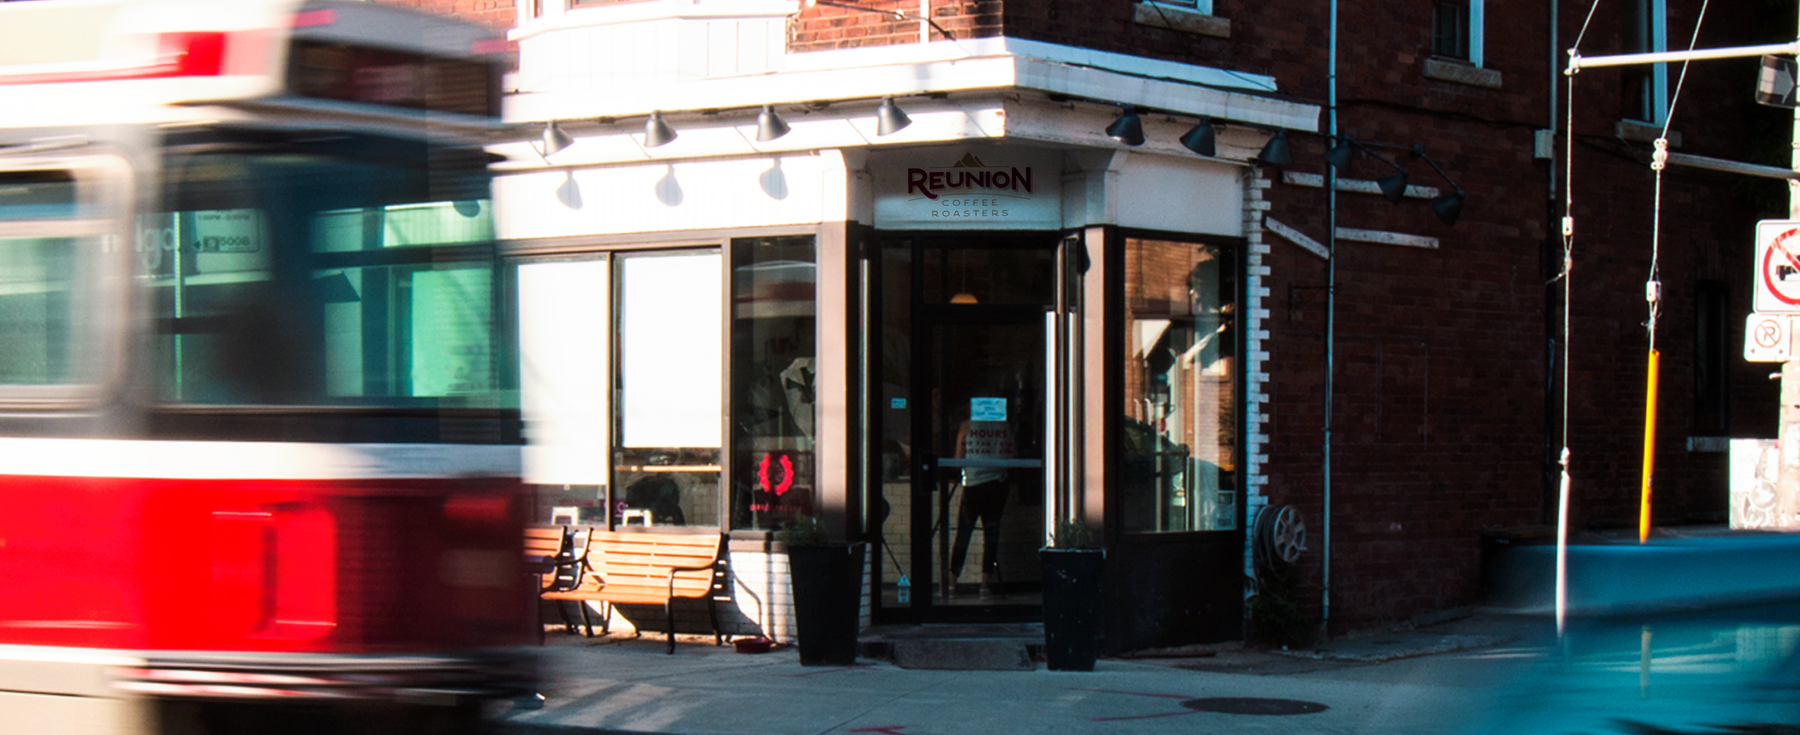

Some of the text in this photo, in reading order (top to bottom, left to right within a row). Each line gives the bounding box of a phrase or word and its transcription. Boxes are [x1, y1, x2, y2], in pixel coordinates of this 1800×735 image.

[908, 167, 1032, 200] REUNION
[942, 199, 998, 207] COFFEE
[931, 209, 1009, 217] ROASTERS
[970, 429, 1008, 438] HOURS
